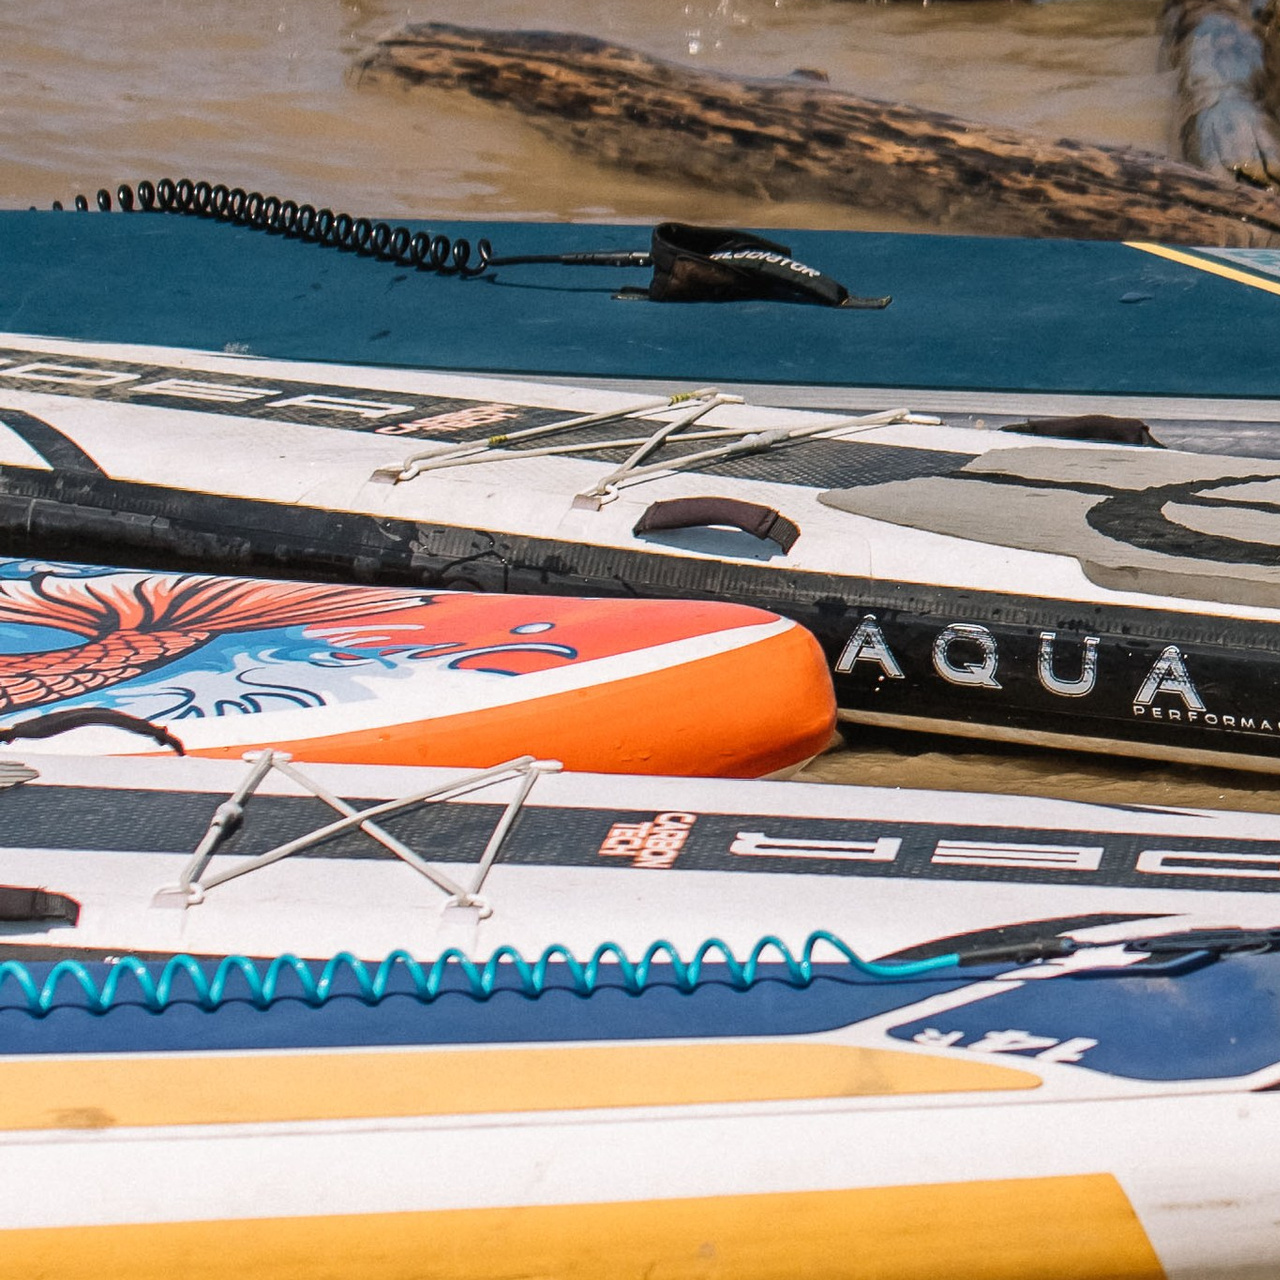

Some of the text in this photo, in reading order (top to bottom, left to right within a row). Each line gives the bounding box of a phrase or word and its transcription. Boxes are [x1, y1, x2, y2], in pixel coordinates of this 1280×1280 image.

[834, 613, 1207, 712] AQUA
[598, 821, 654, 858] TECH
[629, 812, 697, 869] CARBON
